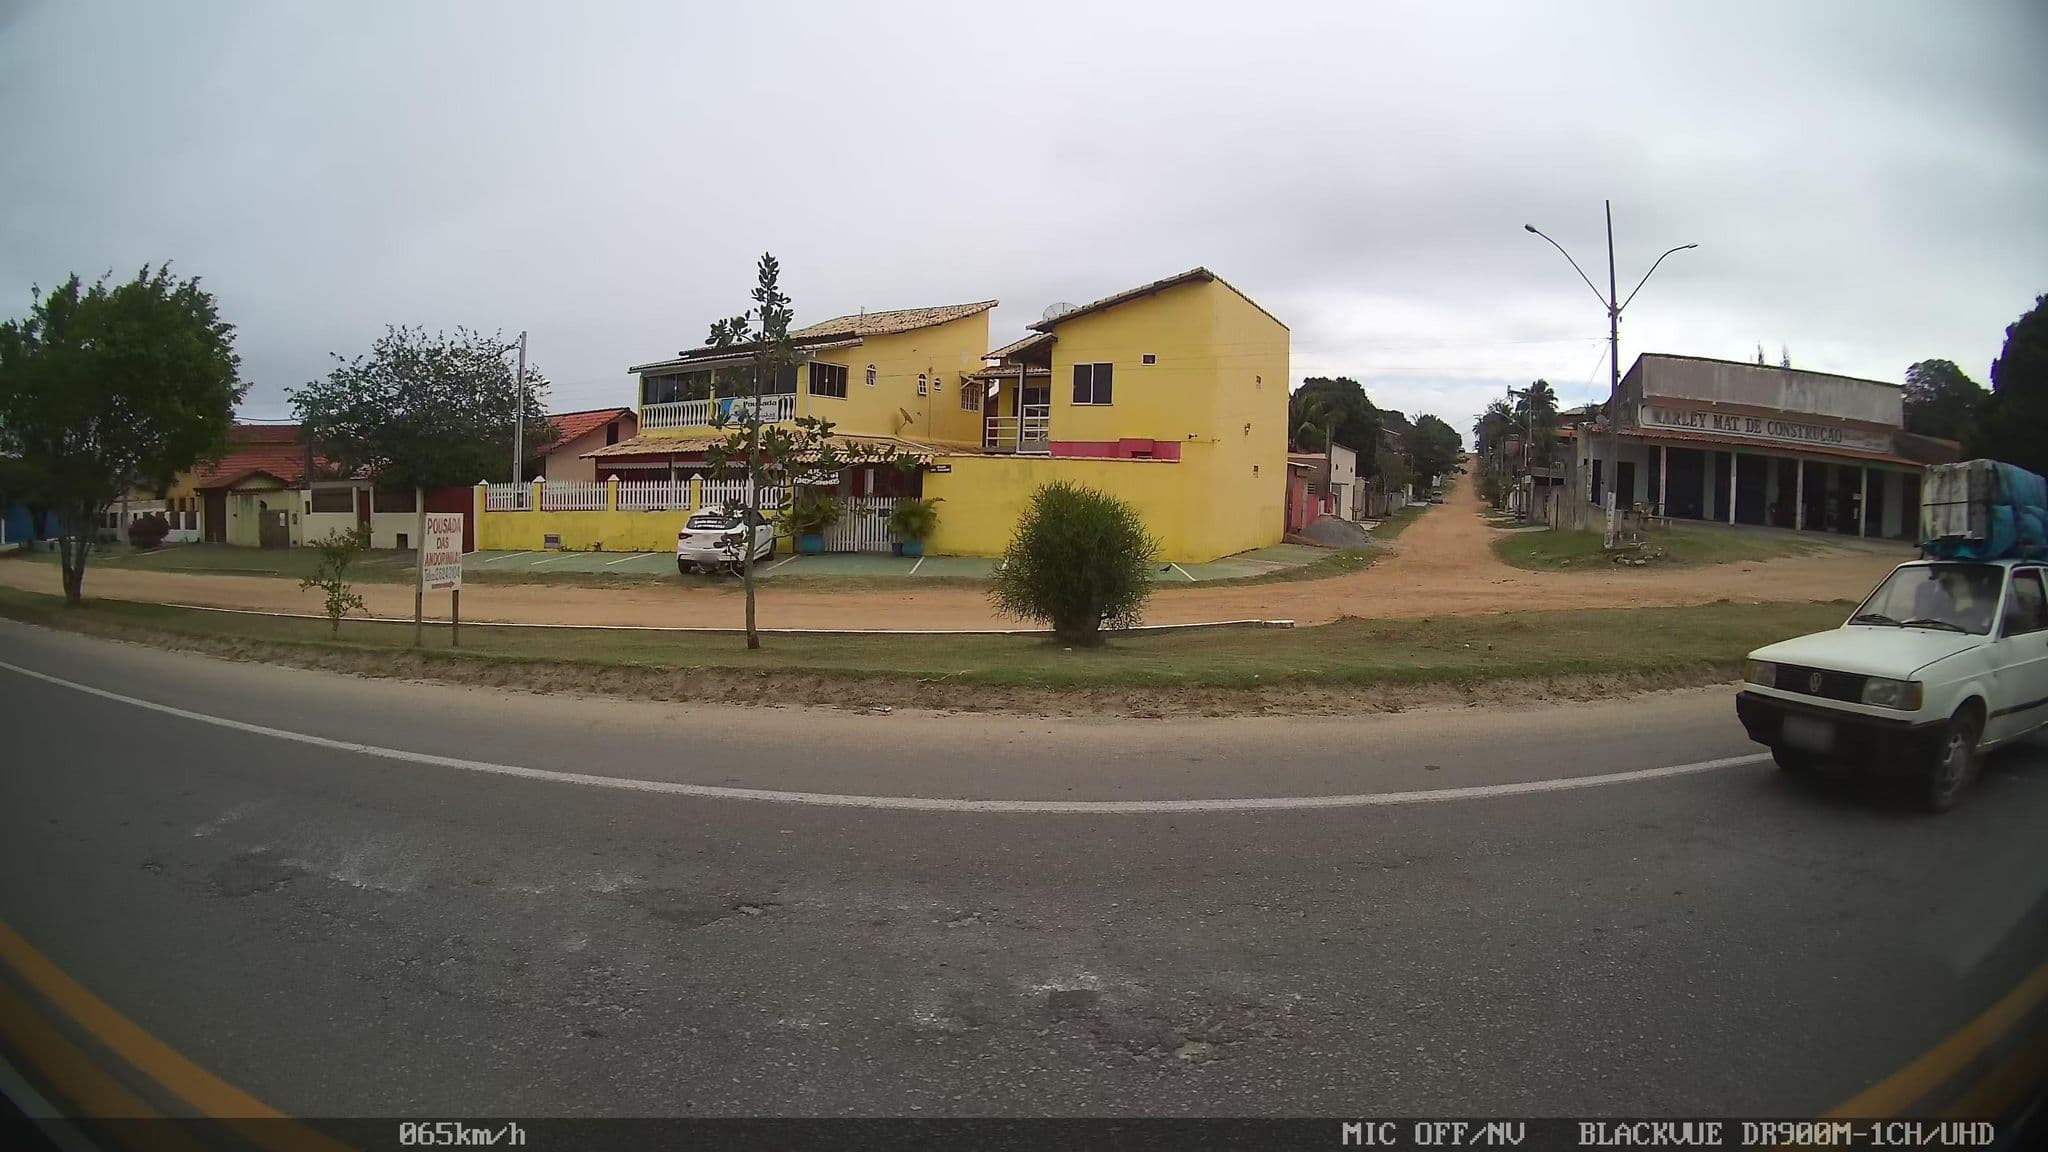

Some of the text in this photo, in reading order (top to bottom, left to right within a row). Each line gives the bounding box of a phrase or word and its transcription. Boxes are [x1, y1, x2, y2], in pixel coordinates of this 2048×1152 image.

[743, 400, 777, 408] Pouada
[1713, 414, 1740, 432] MAT
[1745, 417, 1762, 434] DE
[427, 518, 462, 535] POUSADA
[436, 537, 449, 550] DAS
